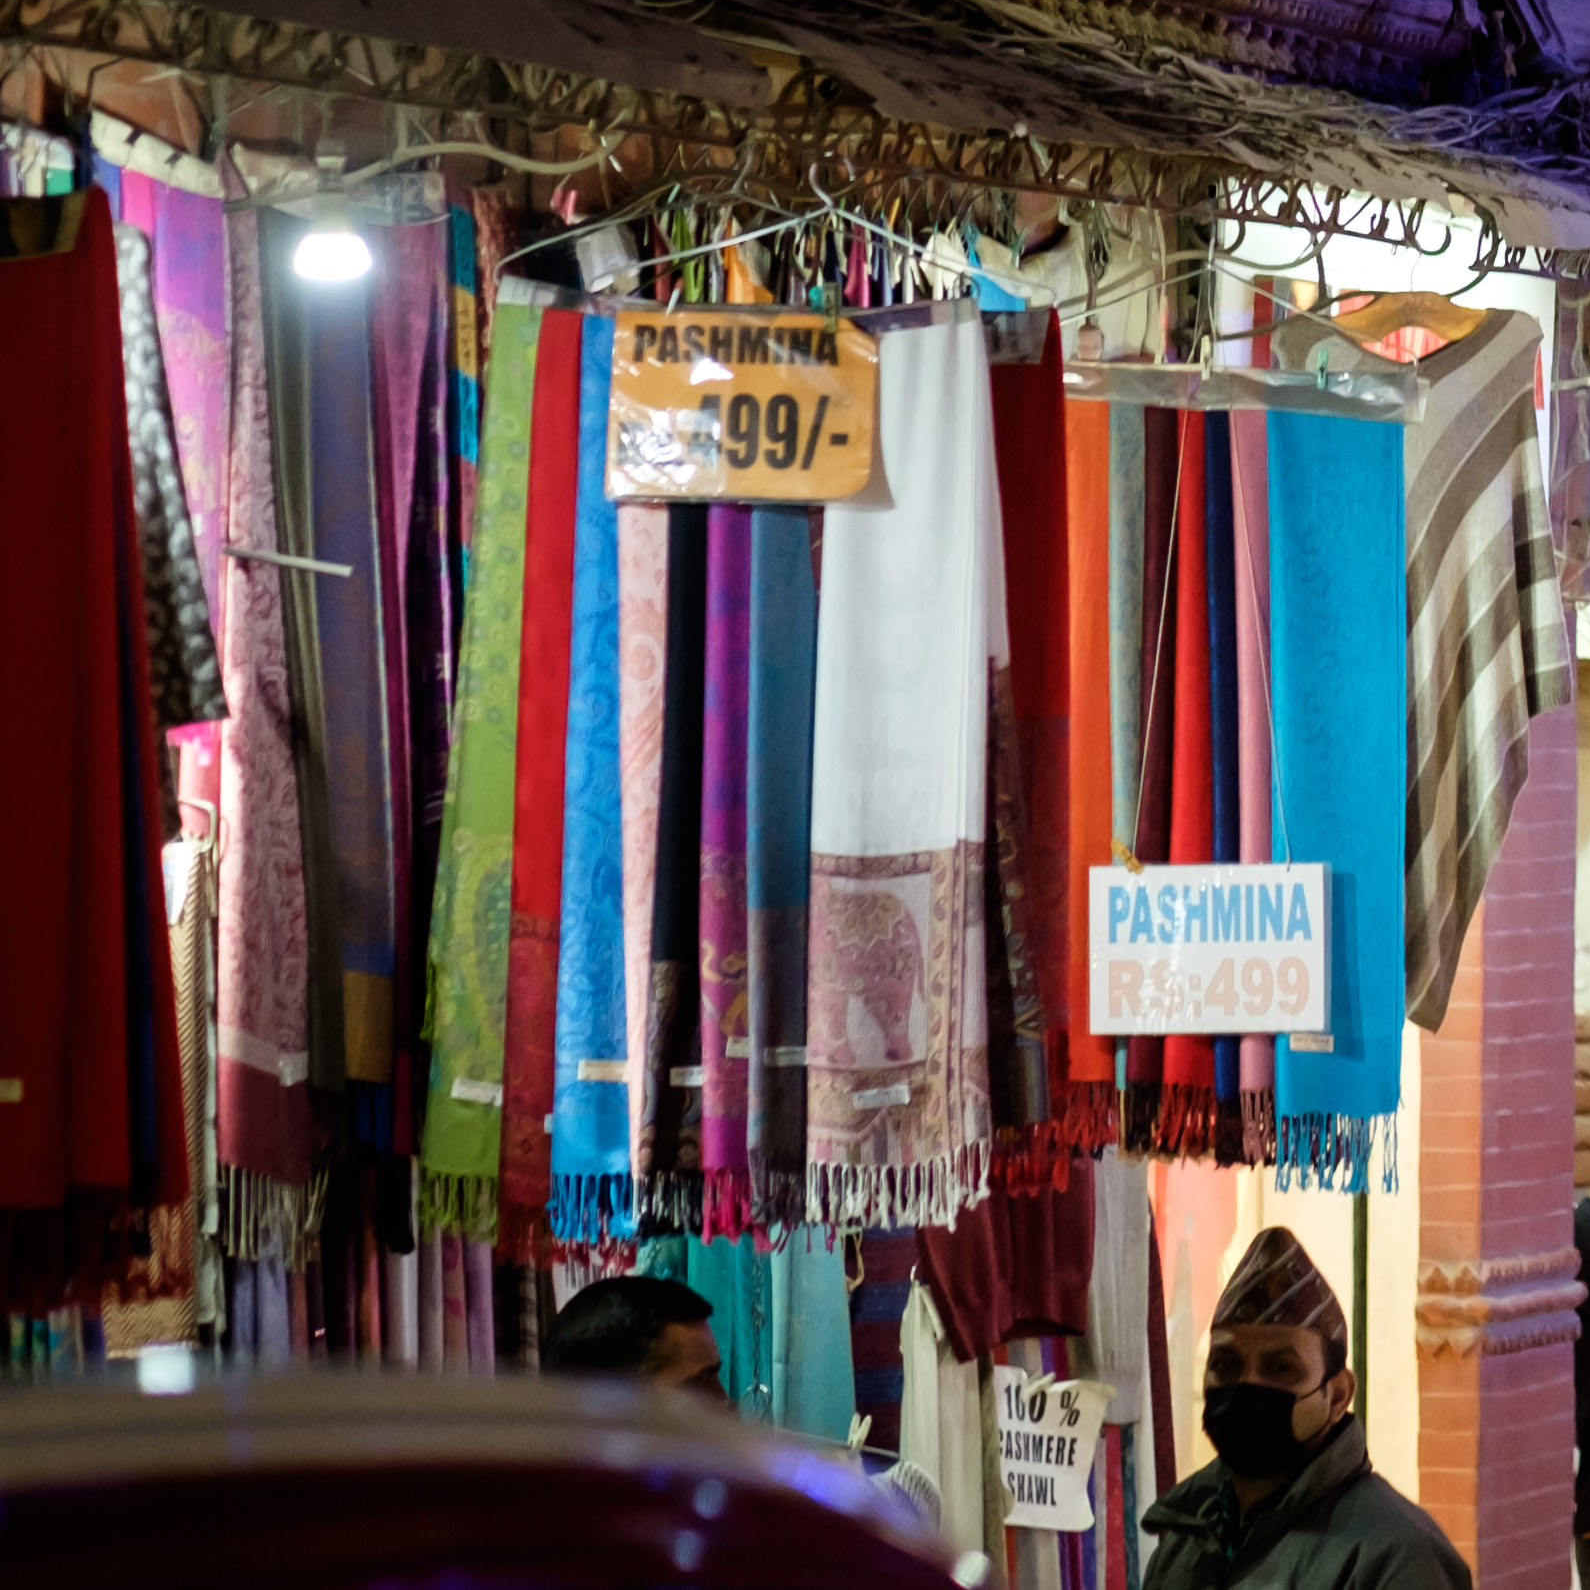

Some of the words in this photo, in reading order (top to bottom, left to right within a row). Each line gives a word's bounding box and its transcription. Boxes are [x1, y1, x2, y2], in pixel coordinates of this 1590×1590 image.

[632, 324, 839, 366] PASHMINA
[1108, 882, 1312, 945] PASHMINA
[1004, 1383, 1048, 1423] 100
[1060, 1389, 1081, 1427] %
[1007, 1471, 1057, 1507] SHAWL
